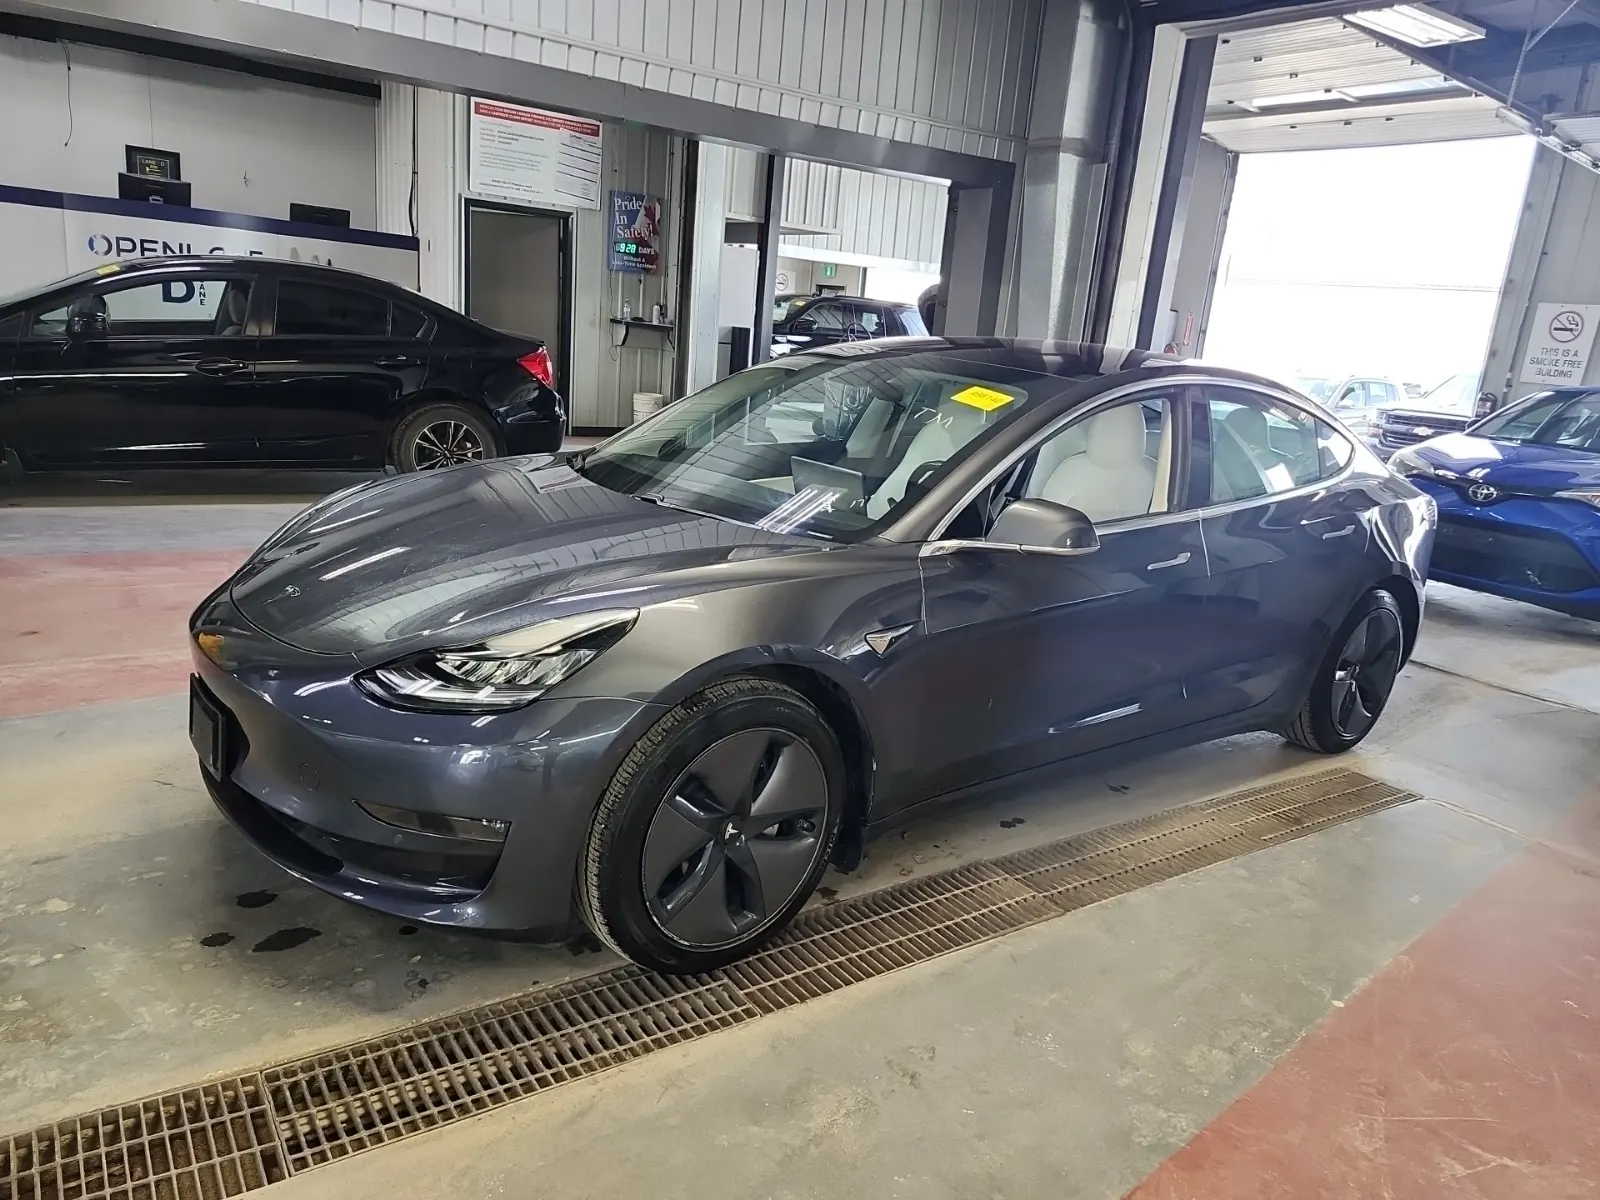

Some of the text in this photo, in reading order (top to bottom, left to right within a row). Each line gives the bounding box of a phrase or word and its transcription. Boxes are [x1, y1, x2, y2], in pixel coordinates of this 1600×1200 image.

[614, 197, 642, 210] Pride
[615, 212, 628, 225] In
[616, 225, 653, 240] Safety!
[198, 280, 206, 306] ANE
[1541, 347, 1579, 358] THIS IS A
[1529, 357, 1582, 368] SMOKE FREE
[1535, 368, 1572, 378] BUILDING
